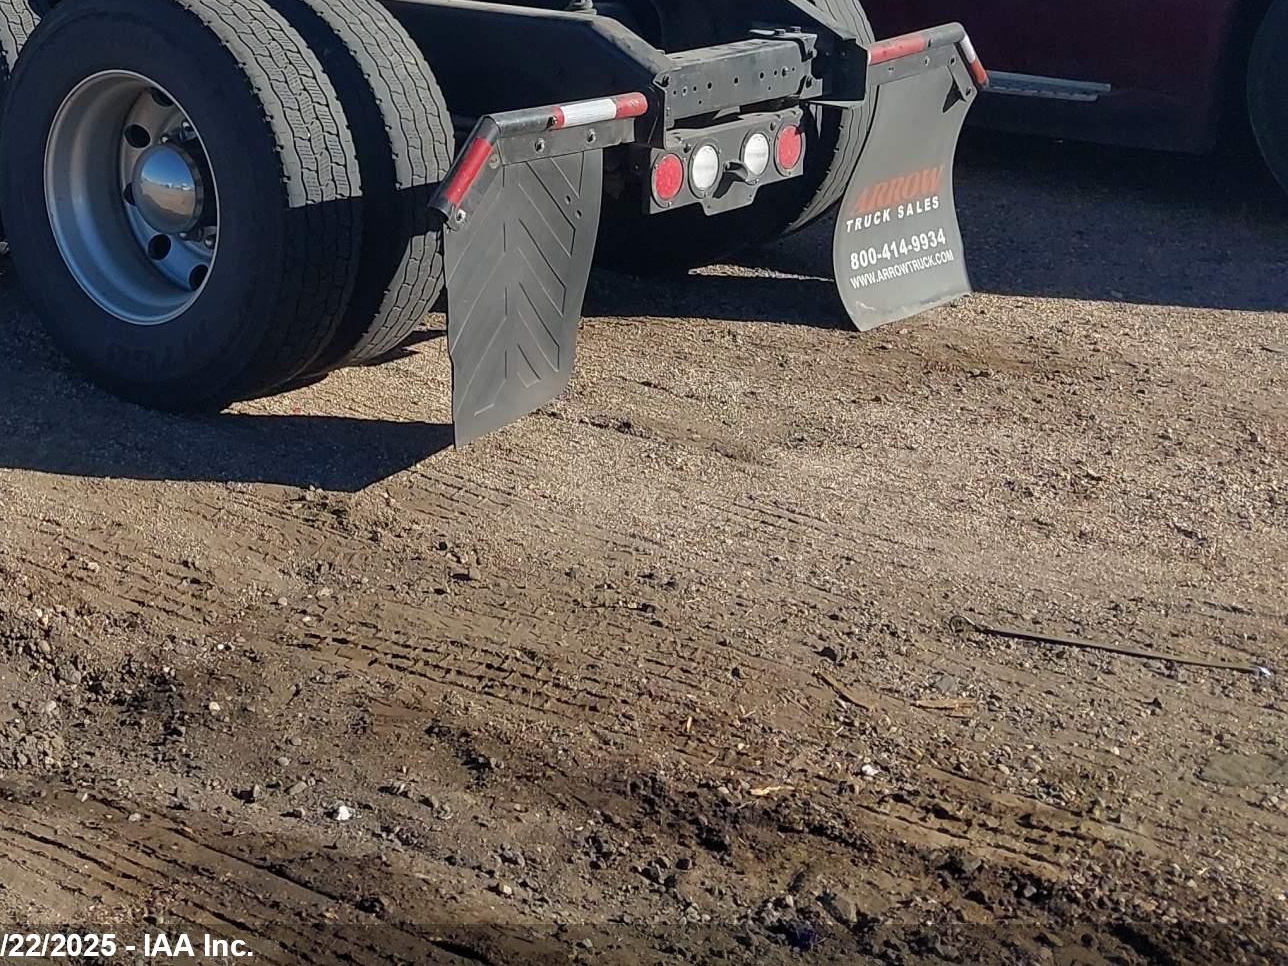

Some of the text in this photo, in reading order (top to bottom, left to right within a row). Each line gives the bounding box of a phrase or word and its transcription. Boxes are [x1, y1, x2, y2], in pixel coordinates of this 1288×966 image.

[846, 195, 940, 233] TRUCK SALES
[850, 228, 947, 270] 800-414-9934
[850, 249, 955, 290] WWW.ARROWTRUCK.COM
